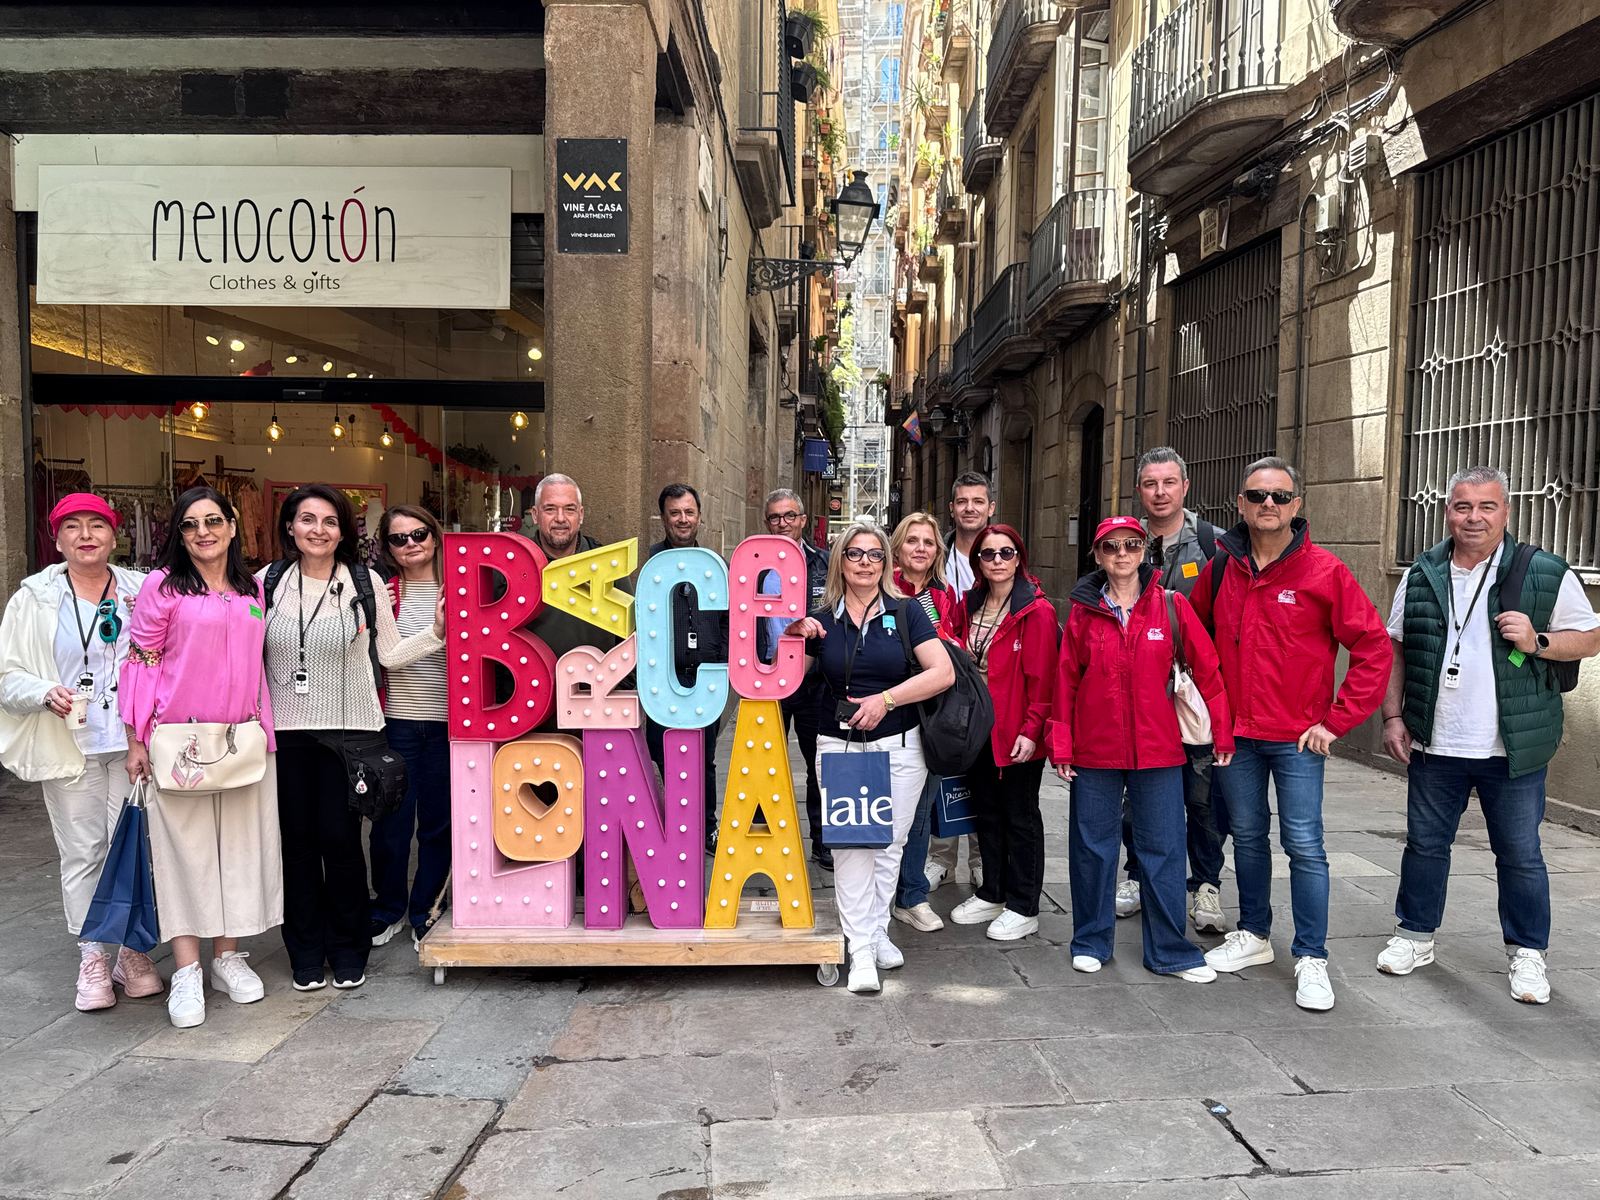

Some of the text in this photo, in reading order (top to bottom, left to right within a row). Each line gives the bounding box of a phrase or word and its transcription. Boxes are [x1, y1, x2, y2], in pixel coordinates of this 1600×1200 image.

[563, 203, 623, 212] VINE A CASA
[209, 271, 340, 293] Clothes & gifts
[821, 786, 893, 826] laie
